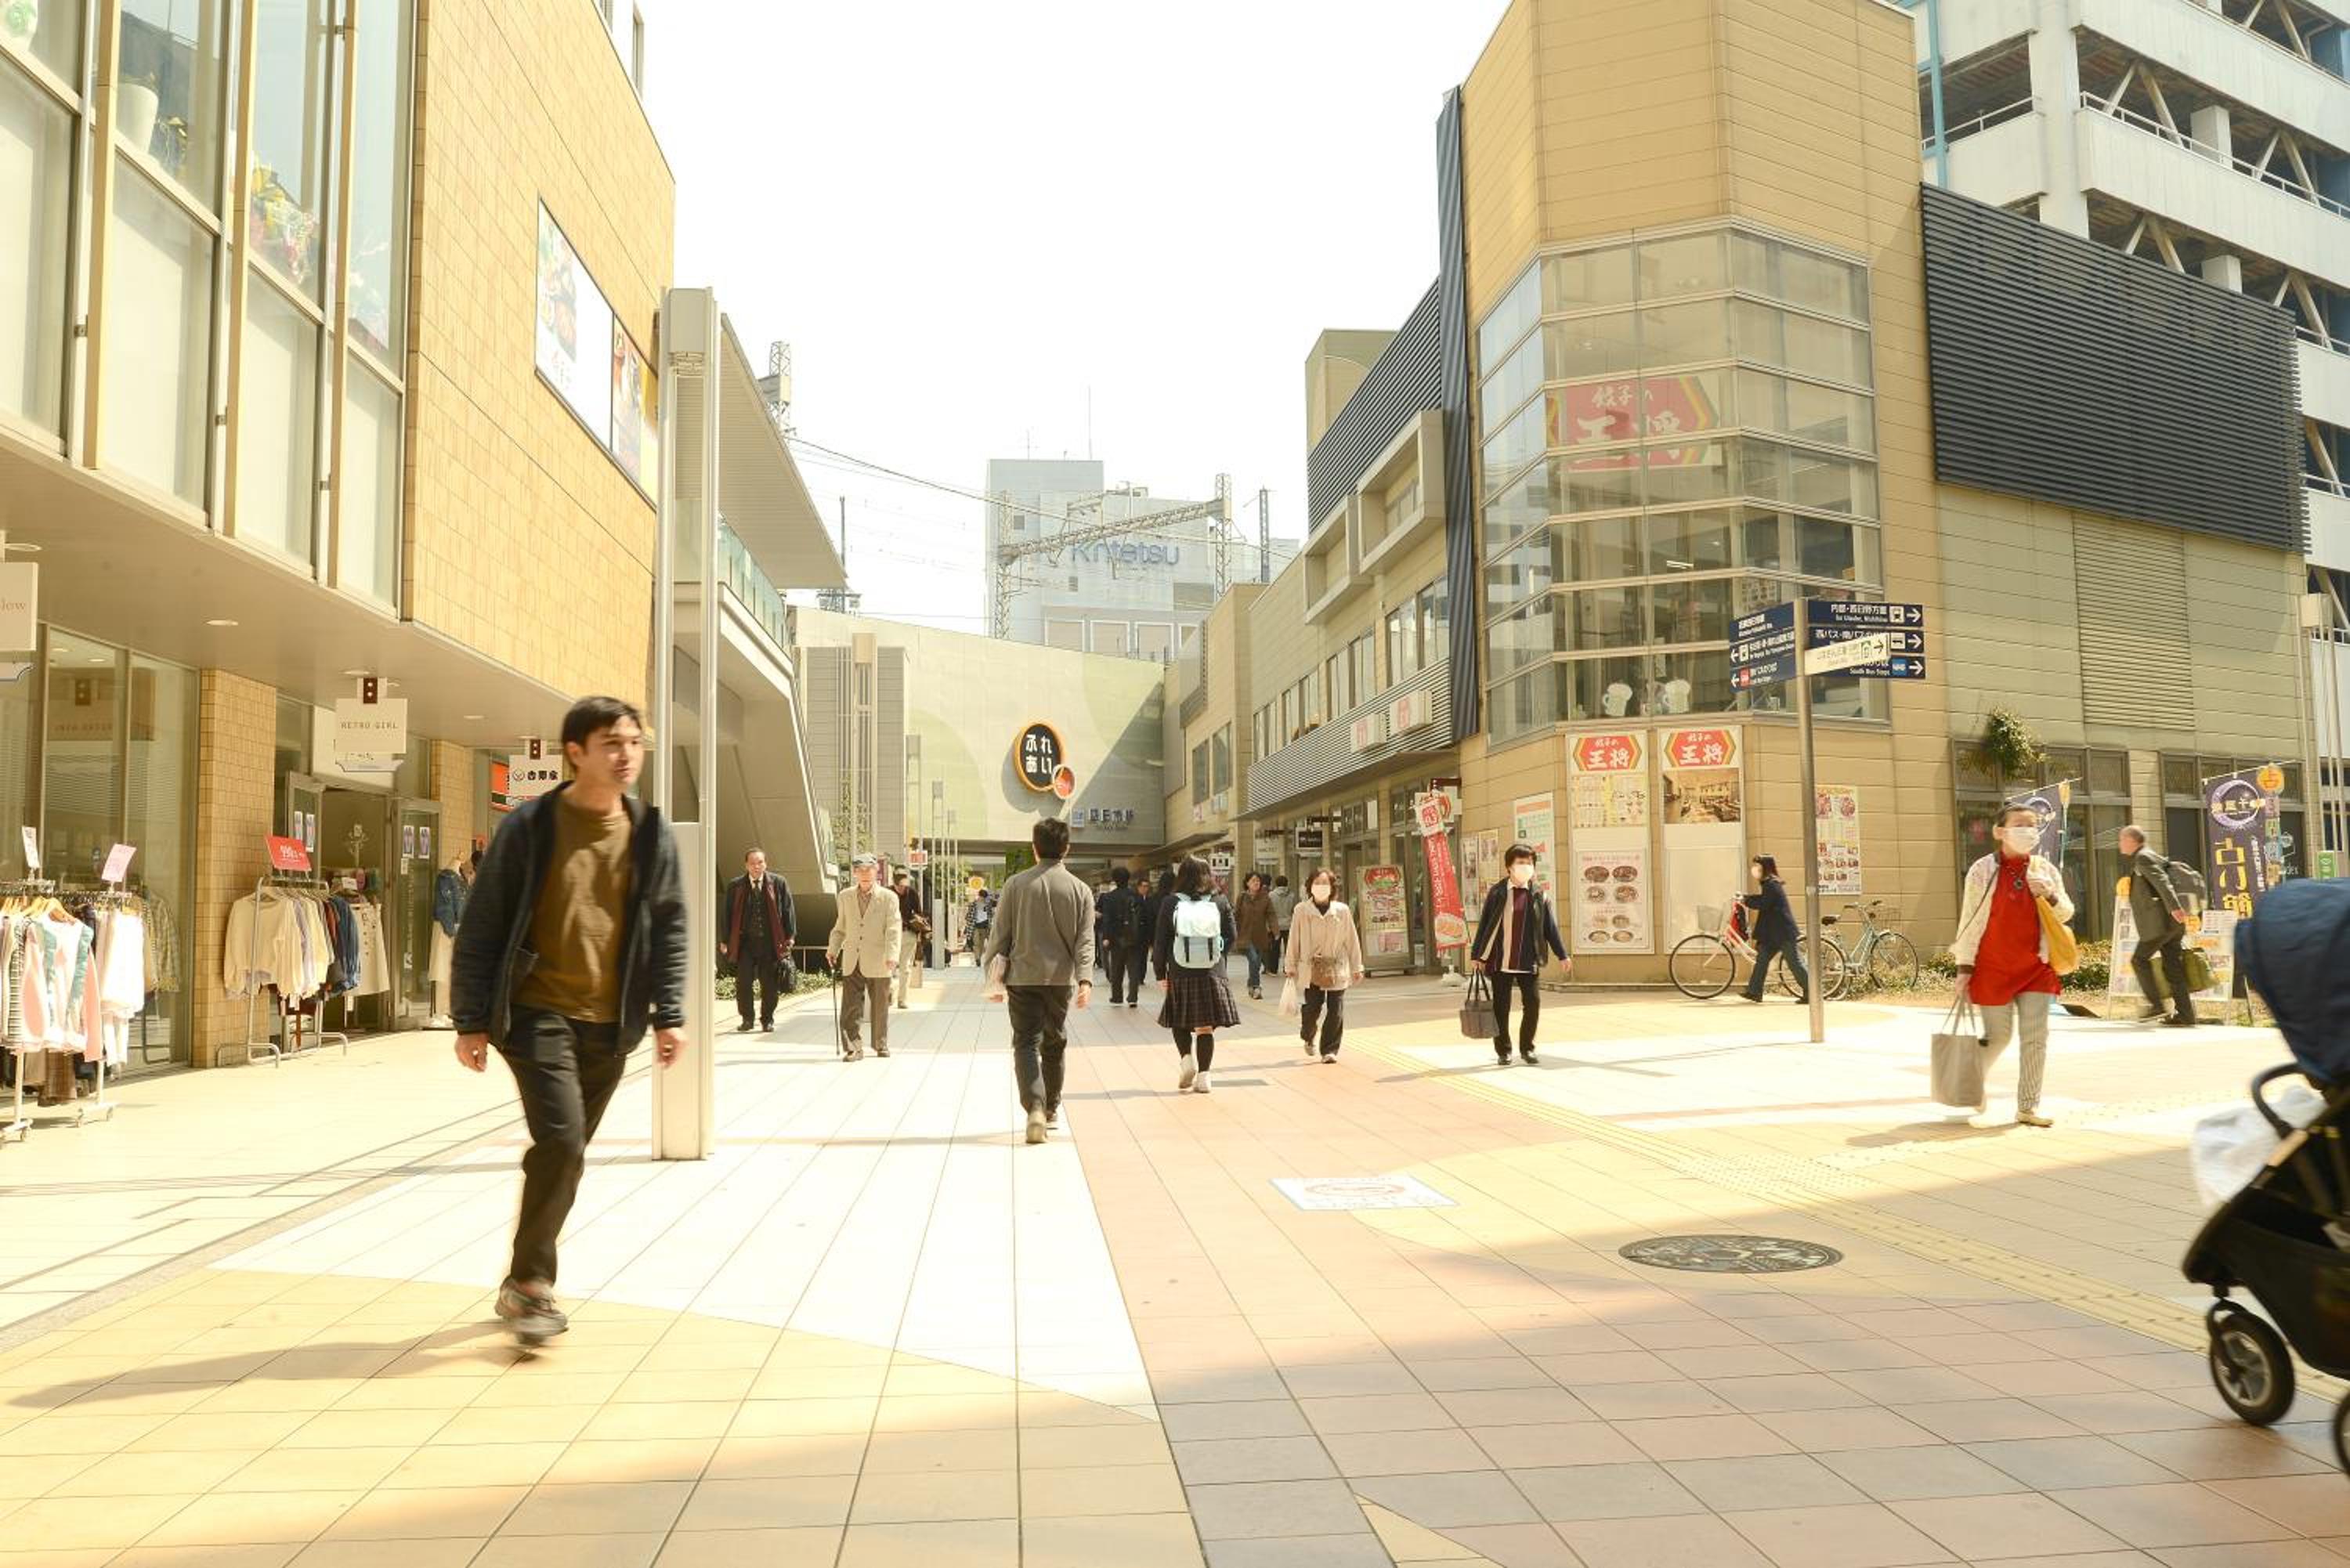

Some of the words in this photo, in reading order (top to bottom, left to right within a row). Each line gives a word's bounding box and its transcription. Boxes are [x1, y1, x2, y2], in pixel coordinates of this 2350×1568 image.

[1025, 734, 1053, 753] ふれ
[1679, 742, 1723, 765] 王将
[1025, 754, 1053, 775] あい
[1586, 747, 1630, 768] 王将
[527, 770, 559, 780] 吉野家
